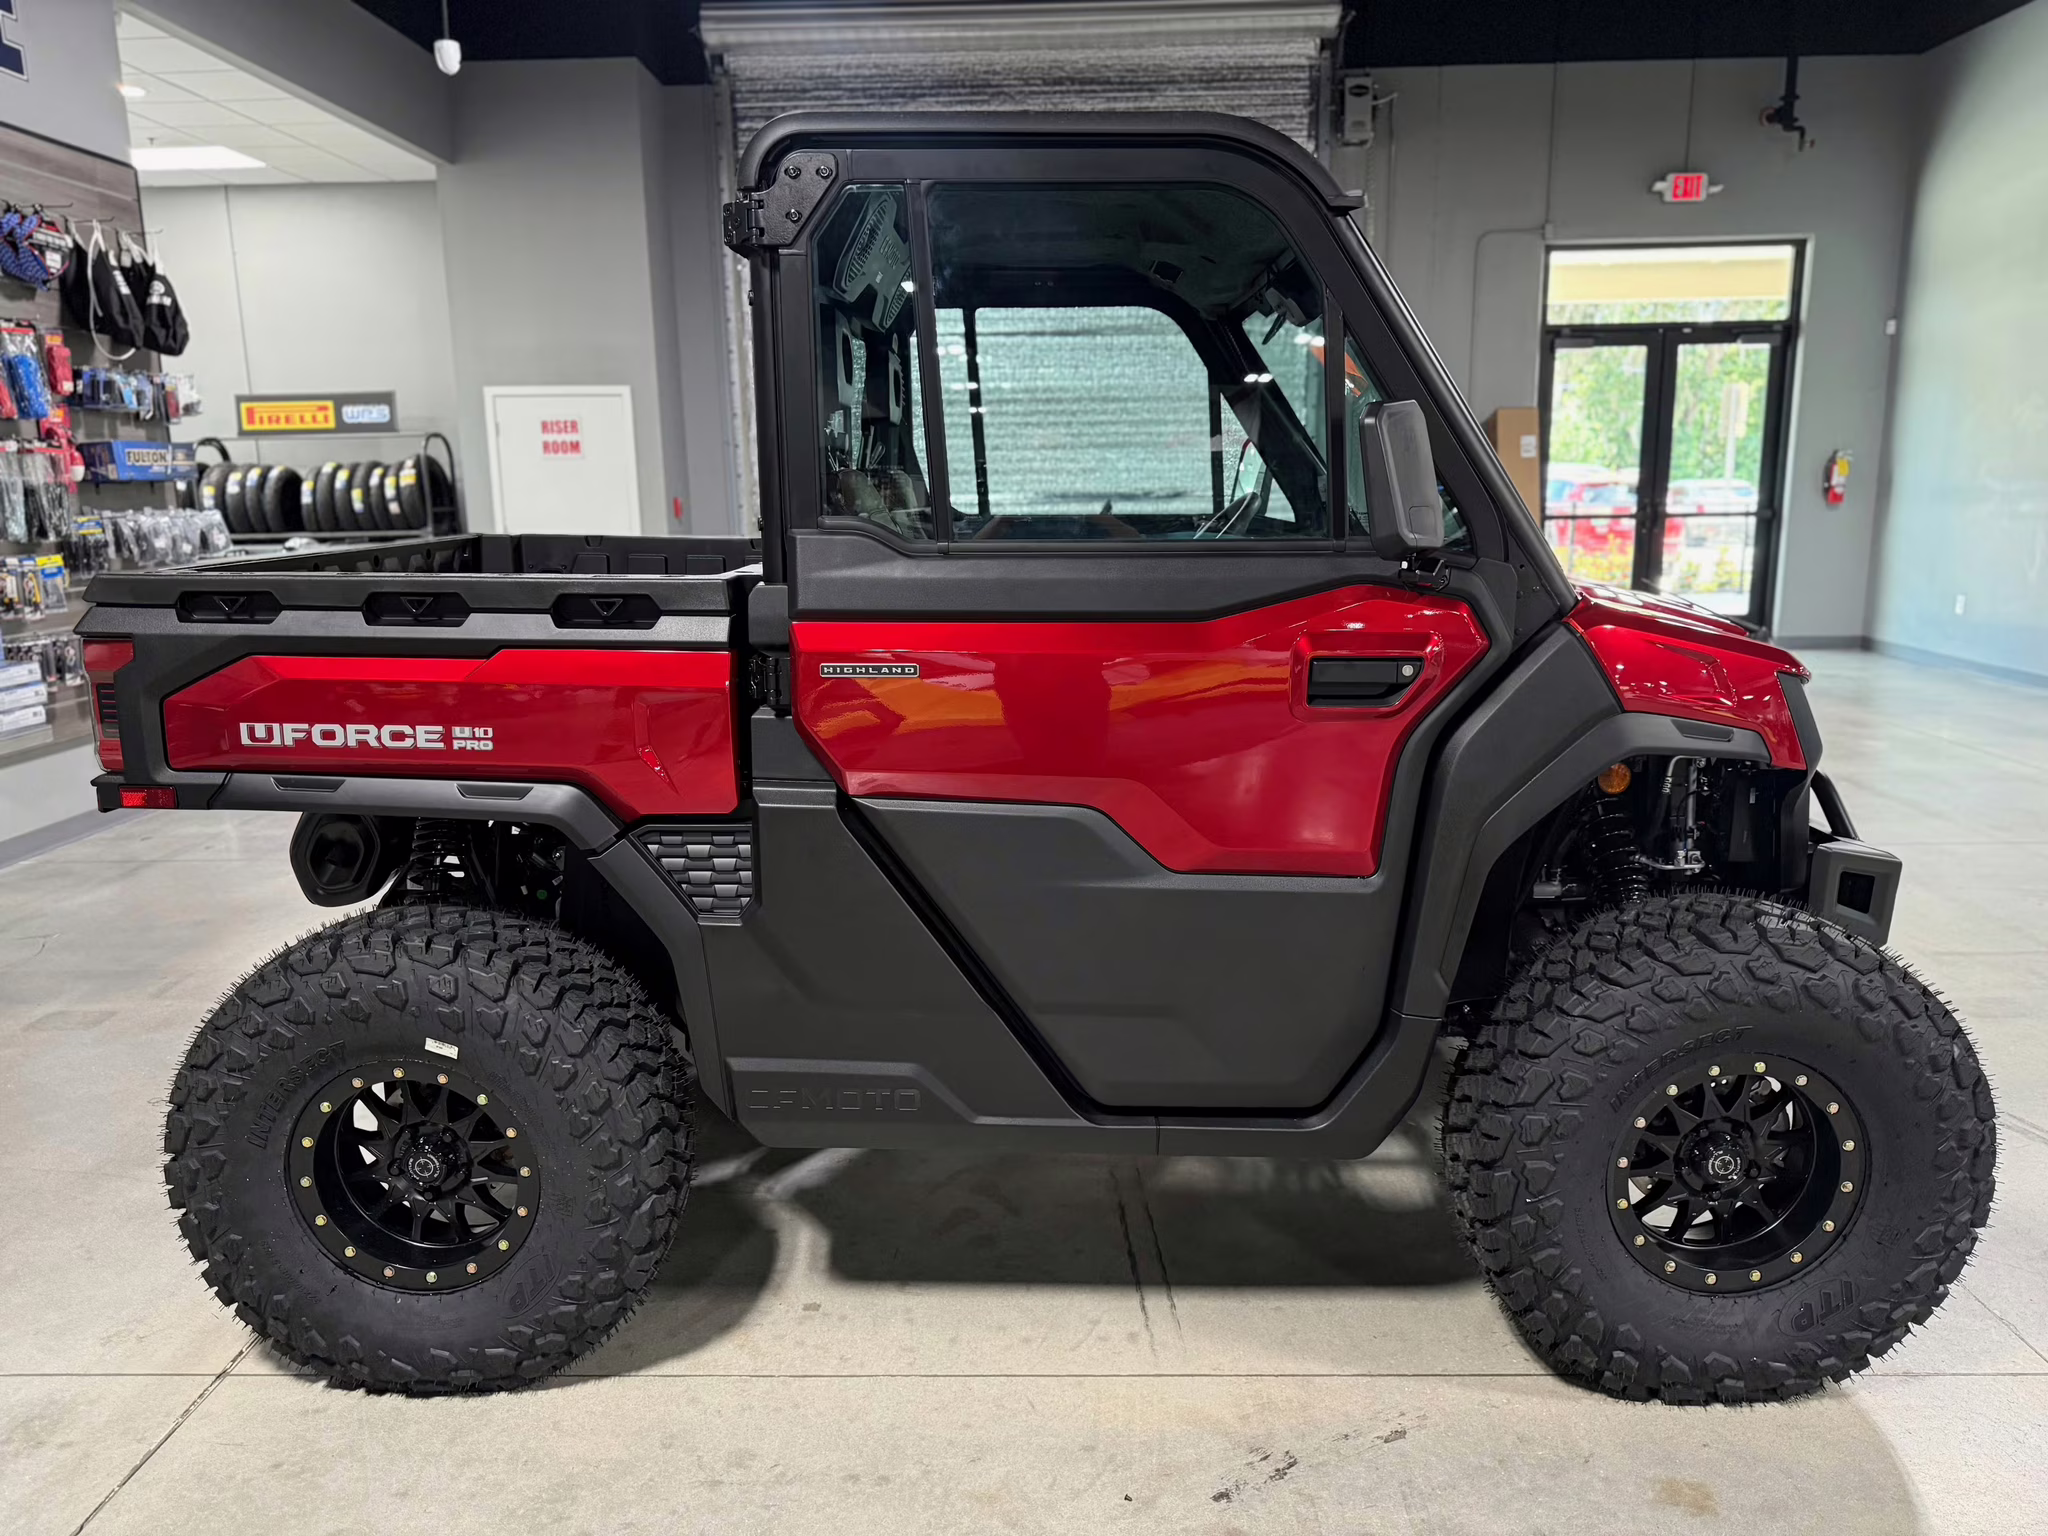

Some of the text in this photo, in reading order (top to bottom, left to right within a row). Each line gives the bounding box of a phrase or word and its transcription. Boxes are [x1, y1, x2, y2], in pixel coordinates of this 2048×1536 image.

[246, 403, 330, 426] PIRELLI
[541, 419, 579, 435] RISER
[127, 449, 168, 464] FULTON
[543, 440, 581, 455] ROOM
[823, 666, 915, 674] HIGHLAND
[452, 739, 494, 751] PRO
[1611, 1025, 1754, 1112] INTERSECT
[247, 1041, 346, 1149] INTERSECT
[510, 1254, 556, 1314] ITP
[1791, 1281, 1854, 1332] ITP
